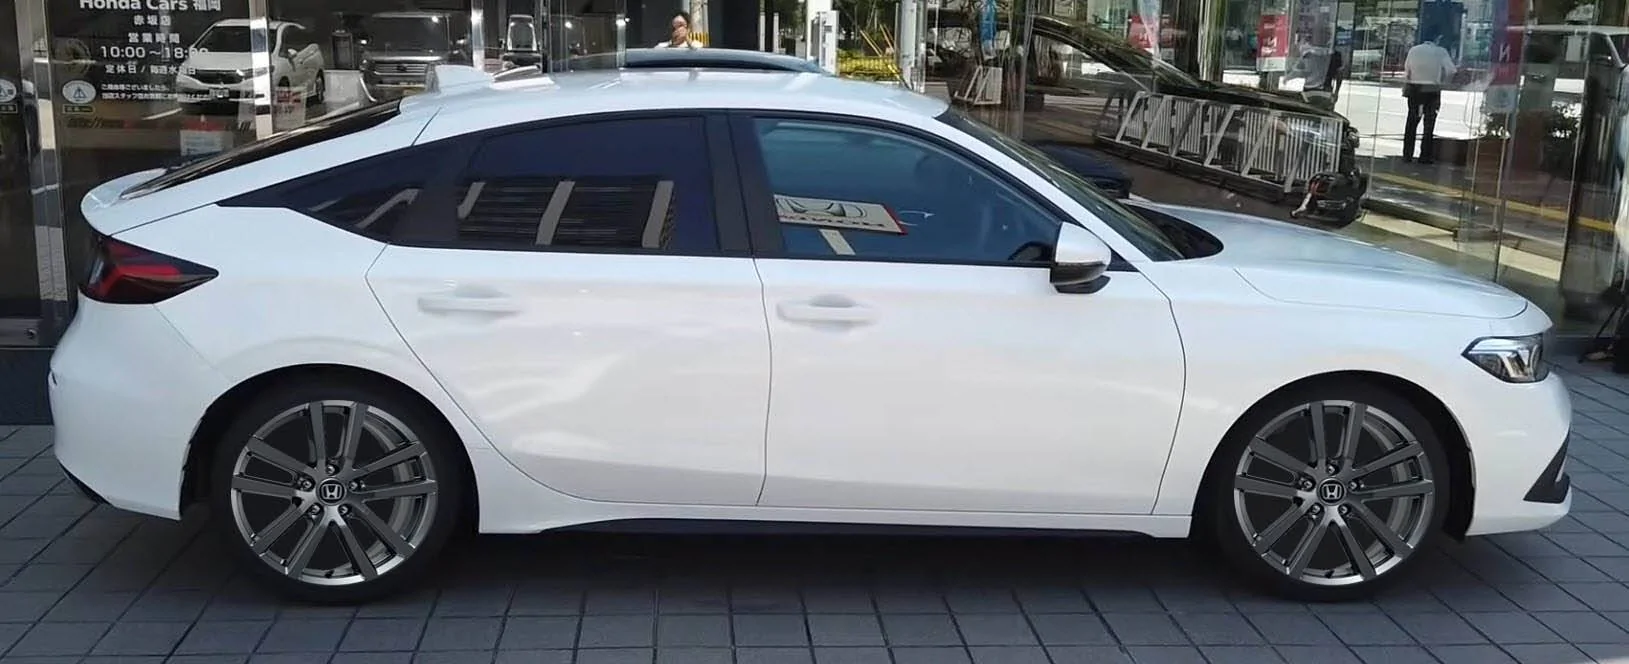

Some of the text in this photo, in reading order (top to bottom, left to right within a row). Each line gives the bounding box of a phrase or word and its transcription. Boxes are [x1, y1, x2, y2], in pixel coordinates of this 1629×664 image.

[79, 0, 142, 9] Honda
[146, 0, 189, 10] Cars
[127, 32, 181, 43] 営業時間
